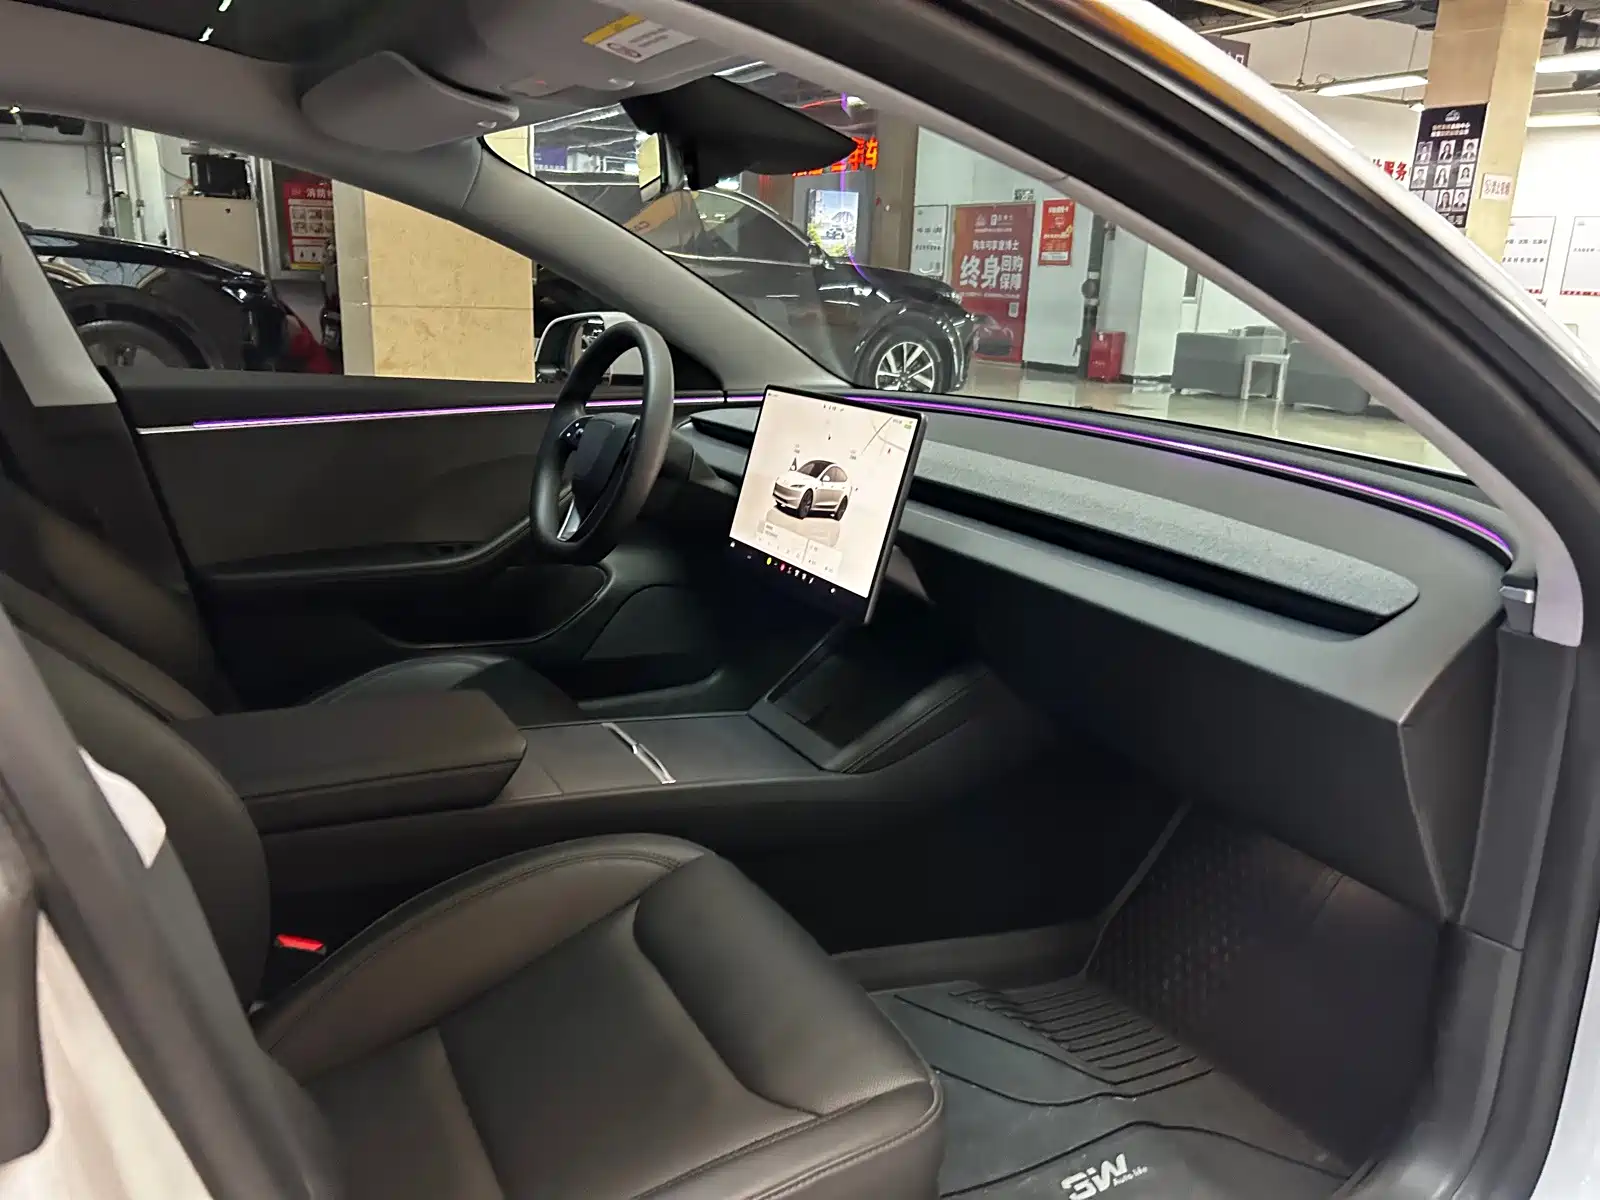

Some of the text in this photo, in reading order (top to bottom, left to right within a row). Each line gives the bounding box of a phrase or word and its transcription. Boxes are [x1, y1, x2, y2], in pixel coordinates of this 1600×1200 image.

[959, 254, 1000, 290] 终身
[1000, 254, 1024, 273] 回购
[999, 272, 1022, 291] 保障
